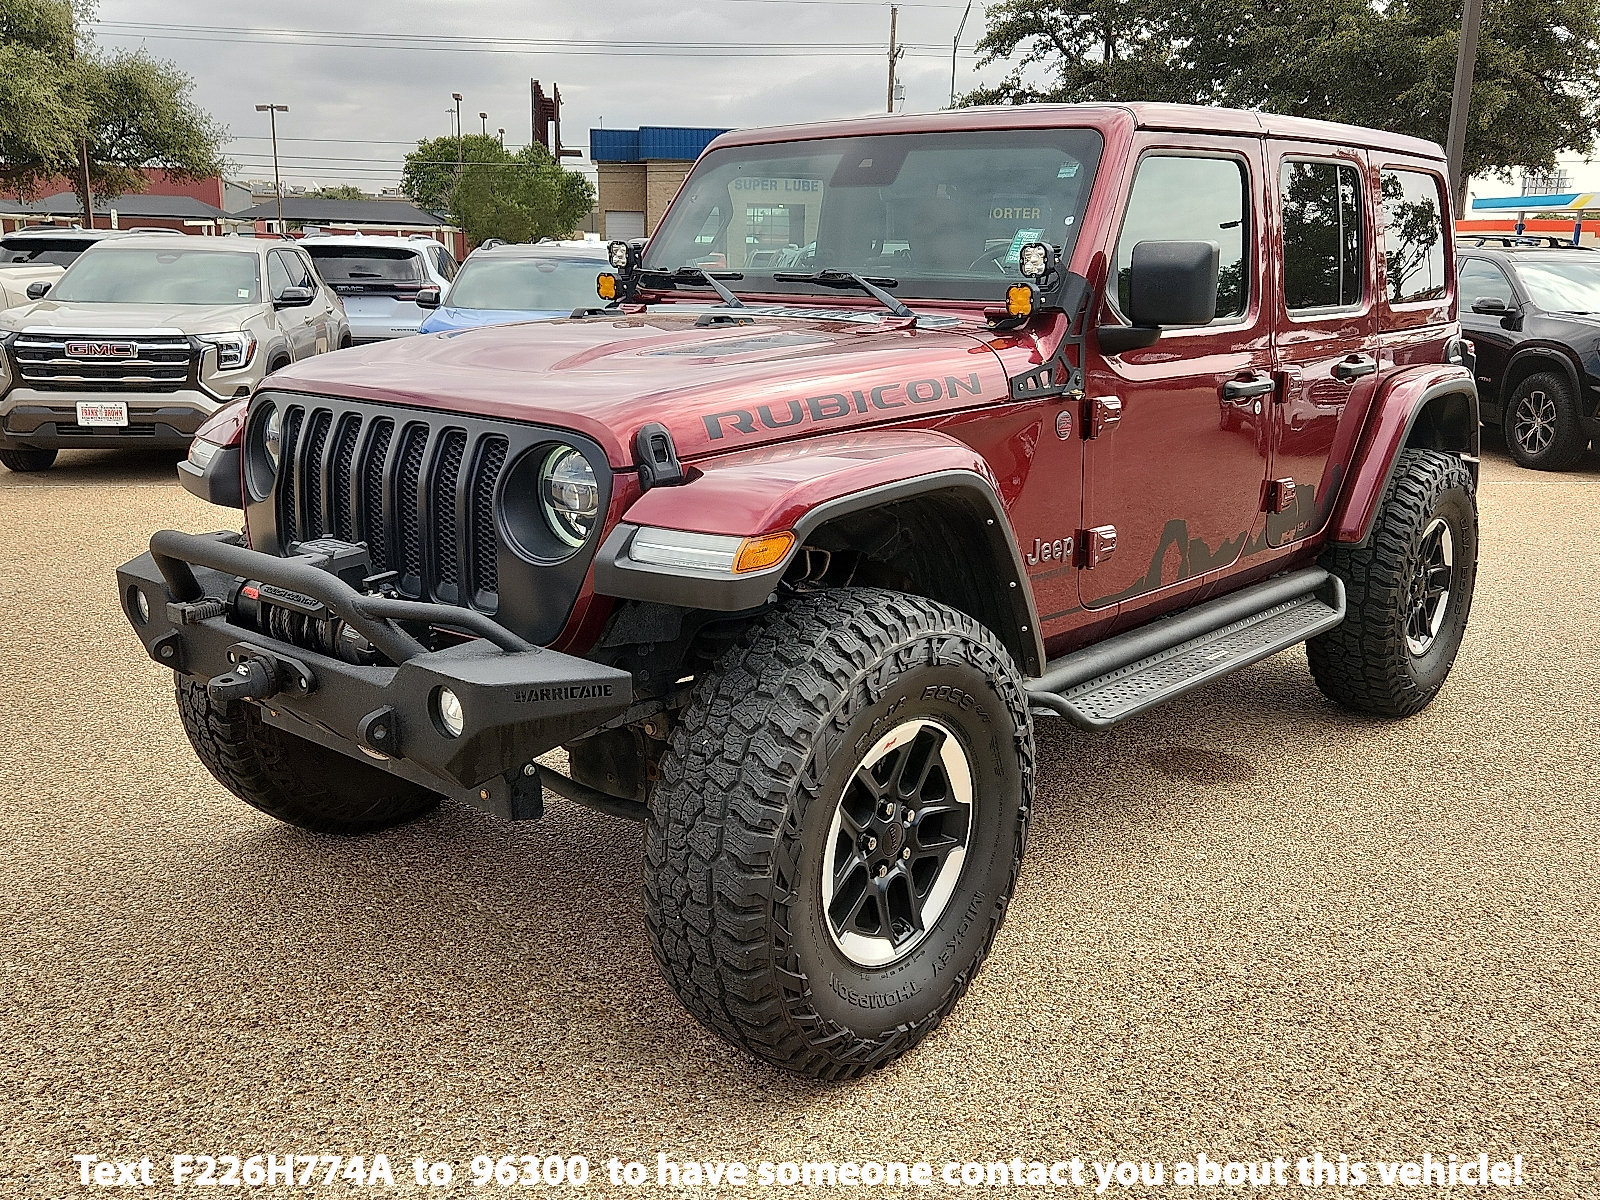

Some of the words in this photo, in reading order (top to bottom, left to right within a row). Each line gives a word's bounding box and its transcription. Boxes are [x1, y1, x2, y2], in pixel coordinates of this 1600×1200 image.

[734, 179, 778, 191] SUPER
[784, 180, 819, 192] LUBE
[989, 207, 1041, 219] ORTER
[67, 343, 132, 357] GMC
[701, 373, 983, 441] RUBICON
[1025, 536, 1074, 566] Jeep
[932, 890, 986, 978] MICKEY
[828, 971, 923, 1009] THOMPSON
